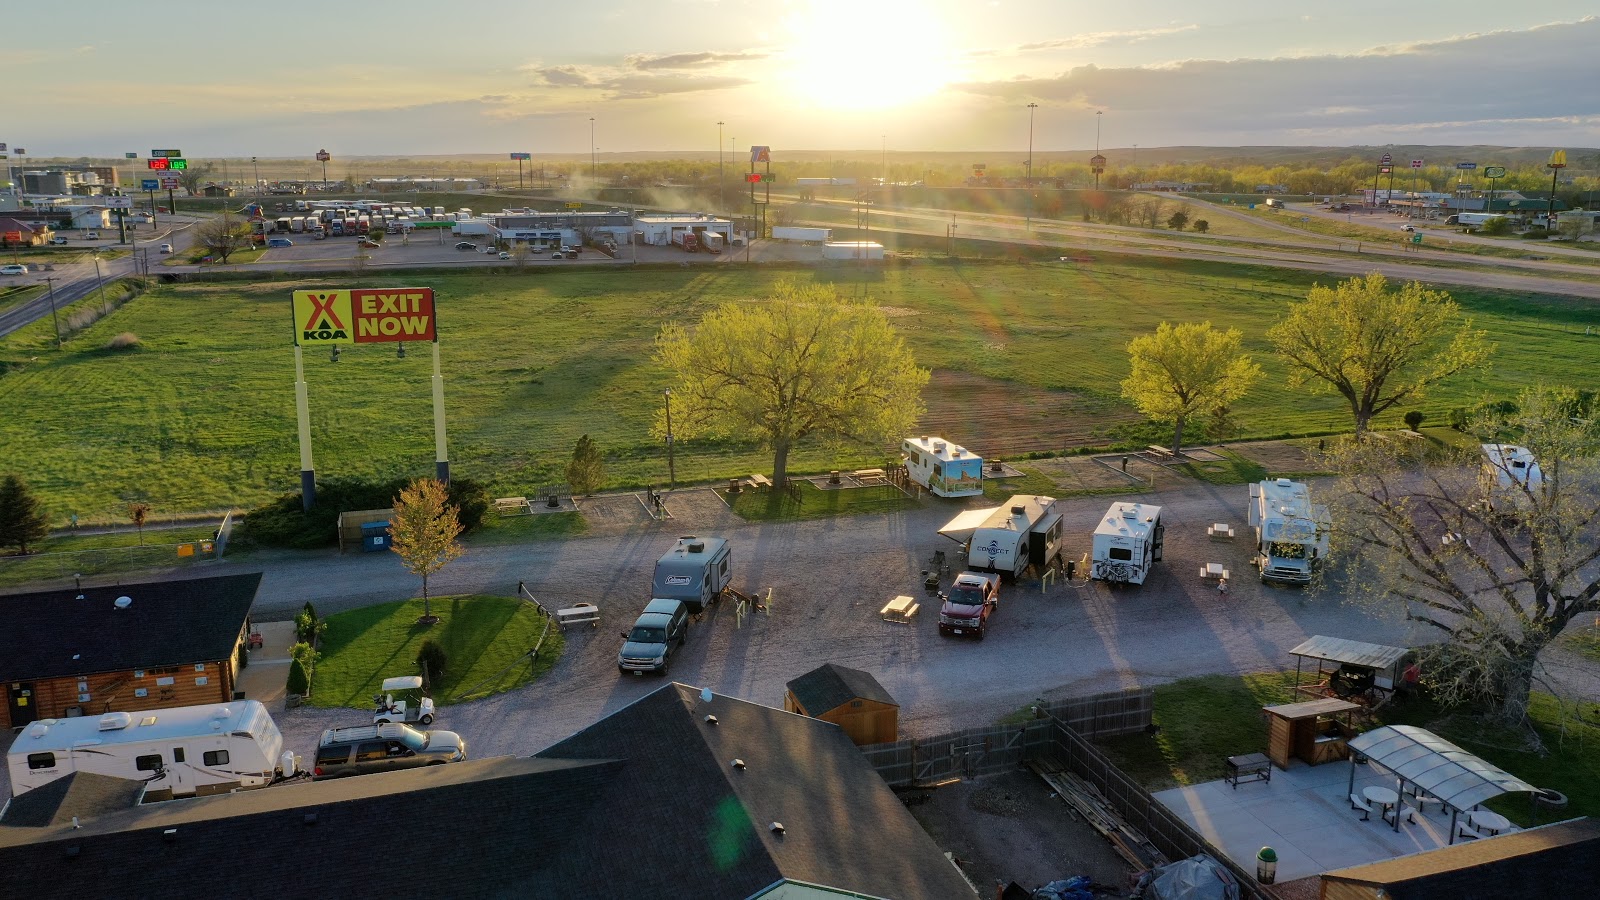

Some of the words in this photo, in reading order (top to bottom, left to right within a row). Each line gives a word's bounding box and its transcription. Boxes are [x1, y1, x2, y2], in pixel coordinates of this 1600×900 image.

[361, 293, 424, 314] EXIT
[303, 329, 348, 340] KOA
[358, 316, 429, 337] NOW
[977, 546, 1010, 554] CONNECT
